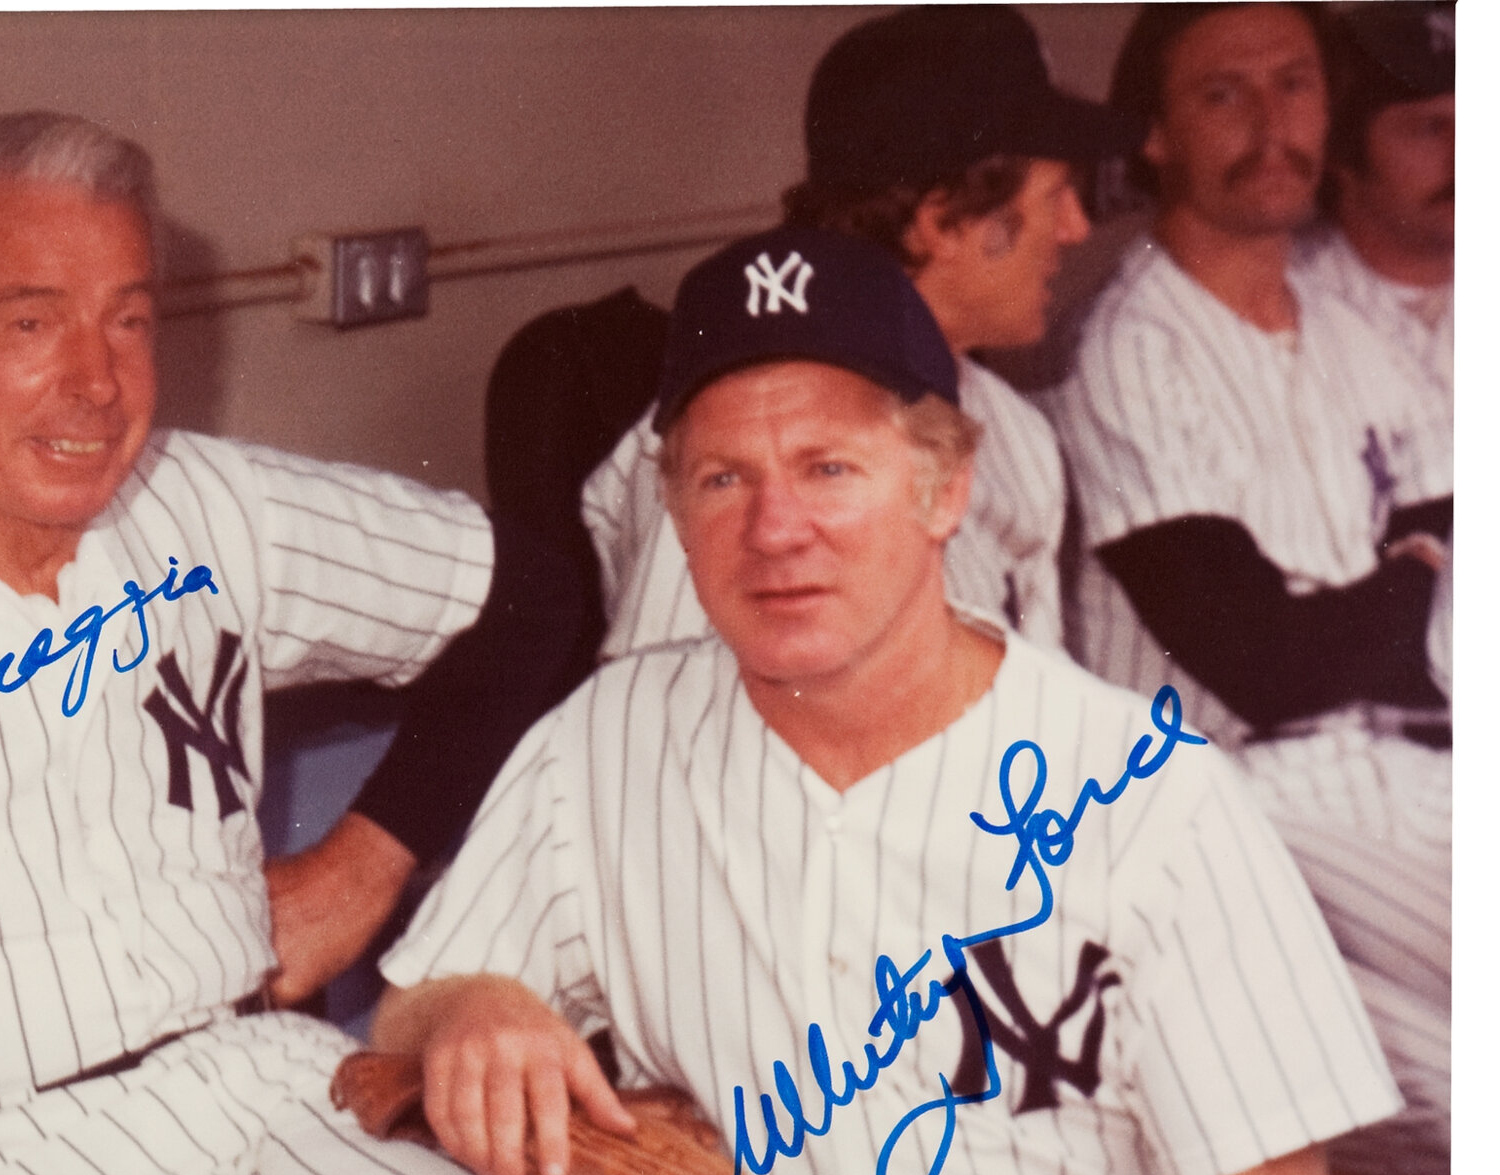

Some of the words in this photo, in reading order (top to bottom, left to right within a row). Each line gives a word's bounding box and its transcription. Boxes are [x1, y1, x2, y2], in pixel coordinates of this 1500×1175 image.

[744, 250, 815, 317] NY
[143, 629, 255, 821] NY
[970, 685, 1208, 915] Ford
[945, 936, 1123, 1116] NY
